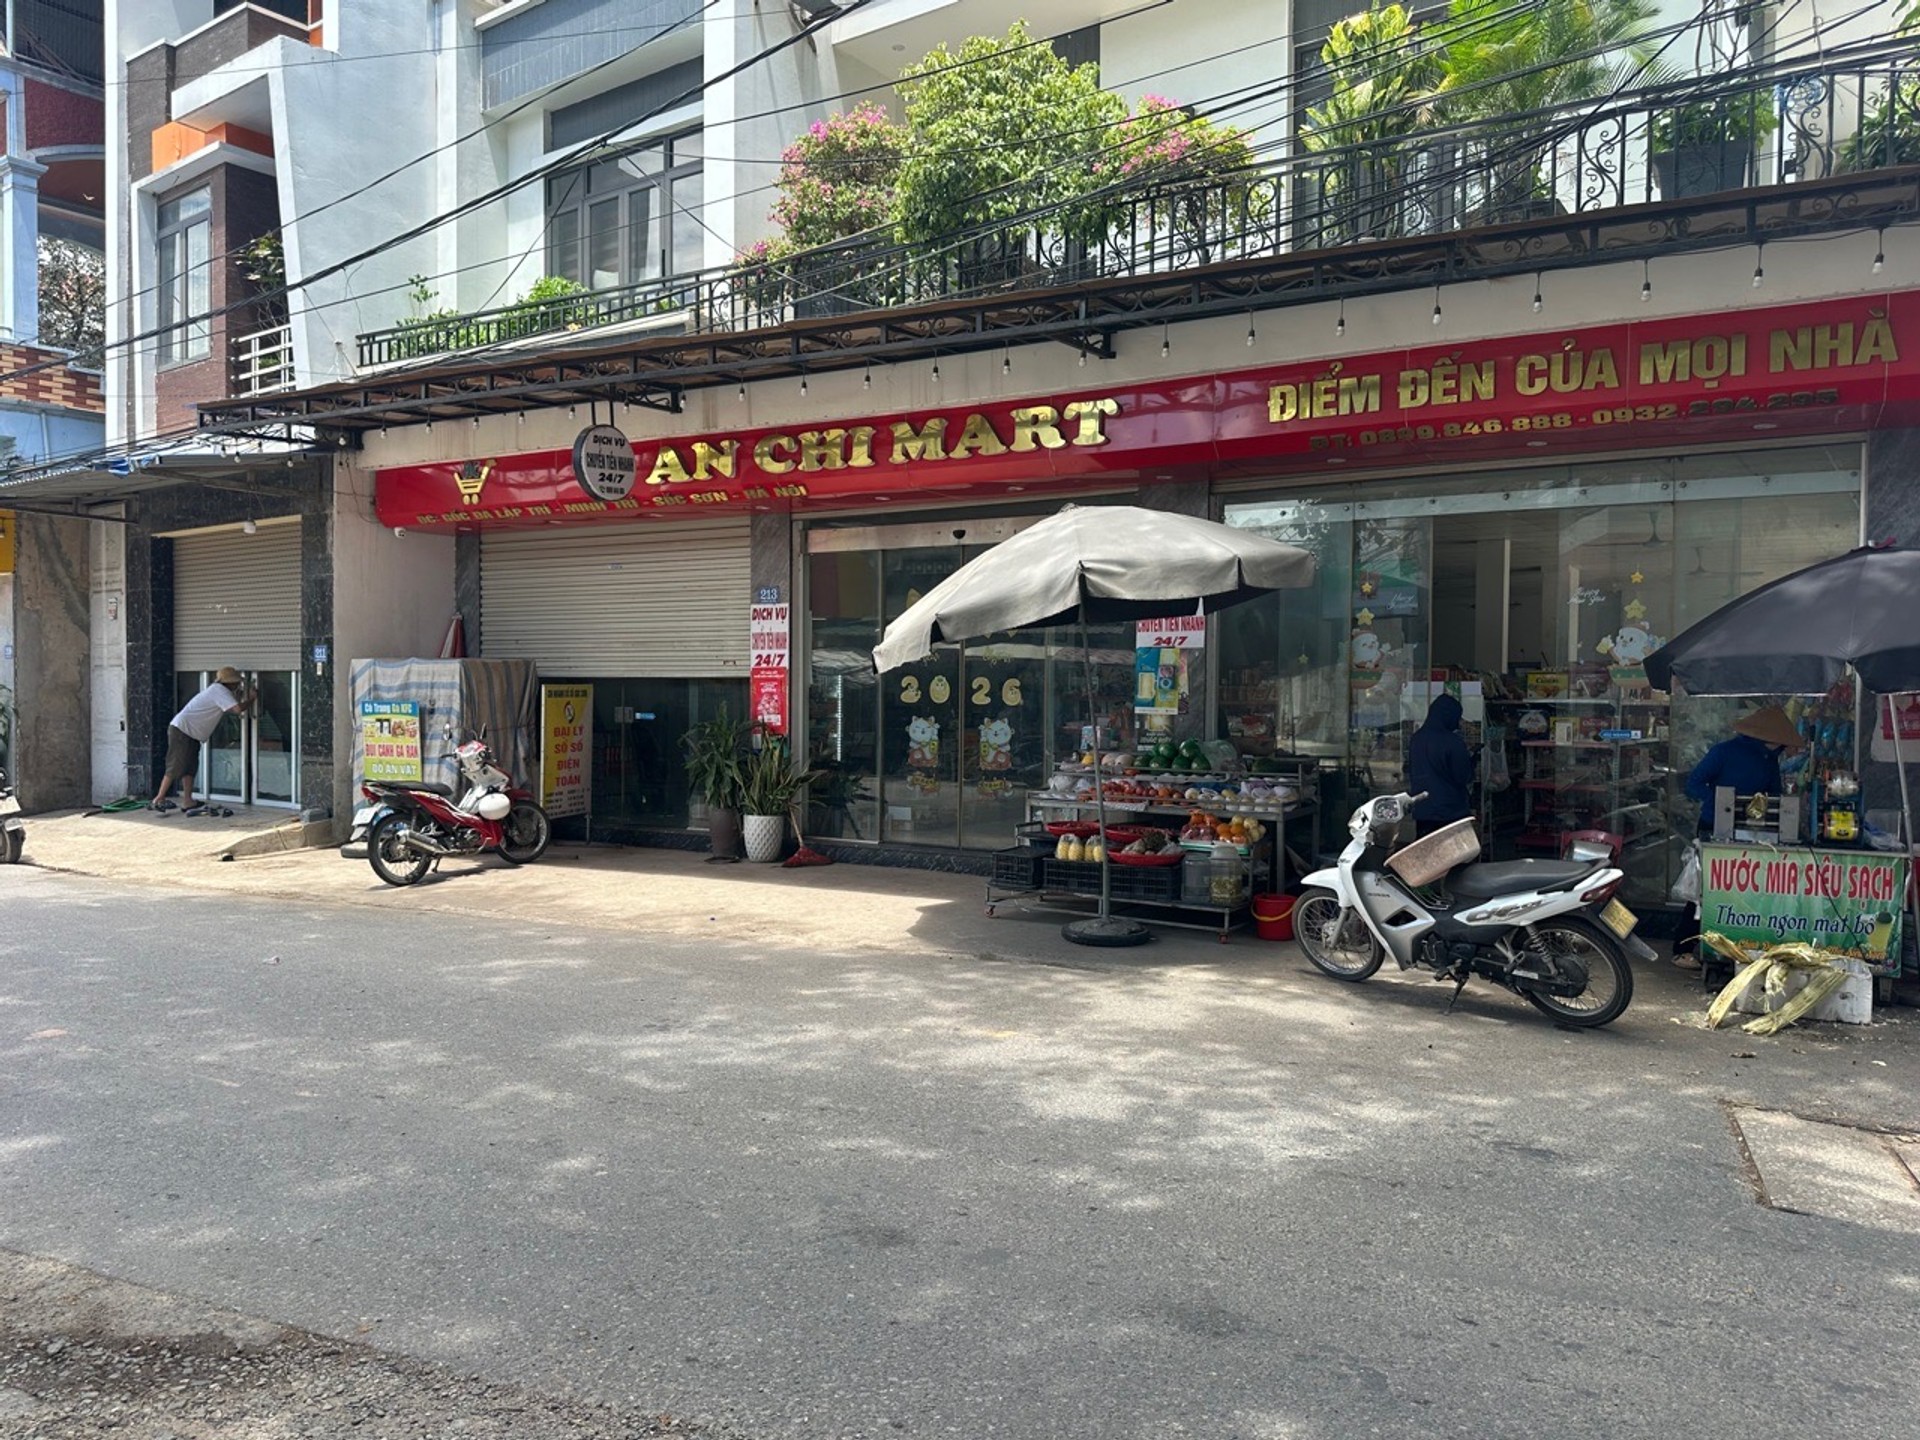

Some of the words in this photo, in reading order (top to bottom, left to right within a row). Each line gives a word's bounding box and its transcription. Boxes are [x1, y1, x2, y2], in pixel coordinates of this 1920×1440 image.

[1268, 361, 1381, 423] ĐIỂM
[1397, 351, 1496, 410] ĐẾN
[1516, 338, 1620, 396] CỦA
[1639, 333, 1747, 389] MỌI
[1769, 308, 1899, 373] NHÀ
[645, 439, 741, 485] AN
[752, 425, 877, 474] CHI
[888, 397, 1120, 464] MART
[598, 472, 625, 484] 24/7
[564, 502, 608, 514] MINH
[760, 588, 778, 600] 213
[752, 607, 774, 625] DỊCH
[775, 607, 787, 624] VỤ
[1154, 636, 1189, 647] 24/7
[754, 653, 786, 668] 24/7
[1710, 851, 1761, 892] NƯỚC
[1766, 854, 1799, 895] MÍA
[1804, 854, 1842, 898] SIÊU
[1848, 864, 1894, 909] SẠCH
[1768, 913, 1808, 938] ngon
